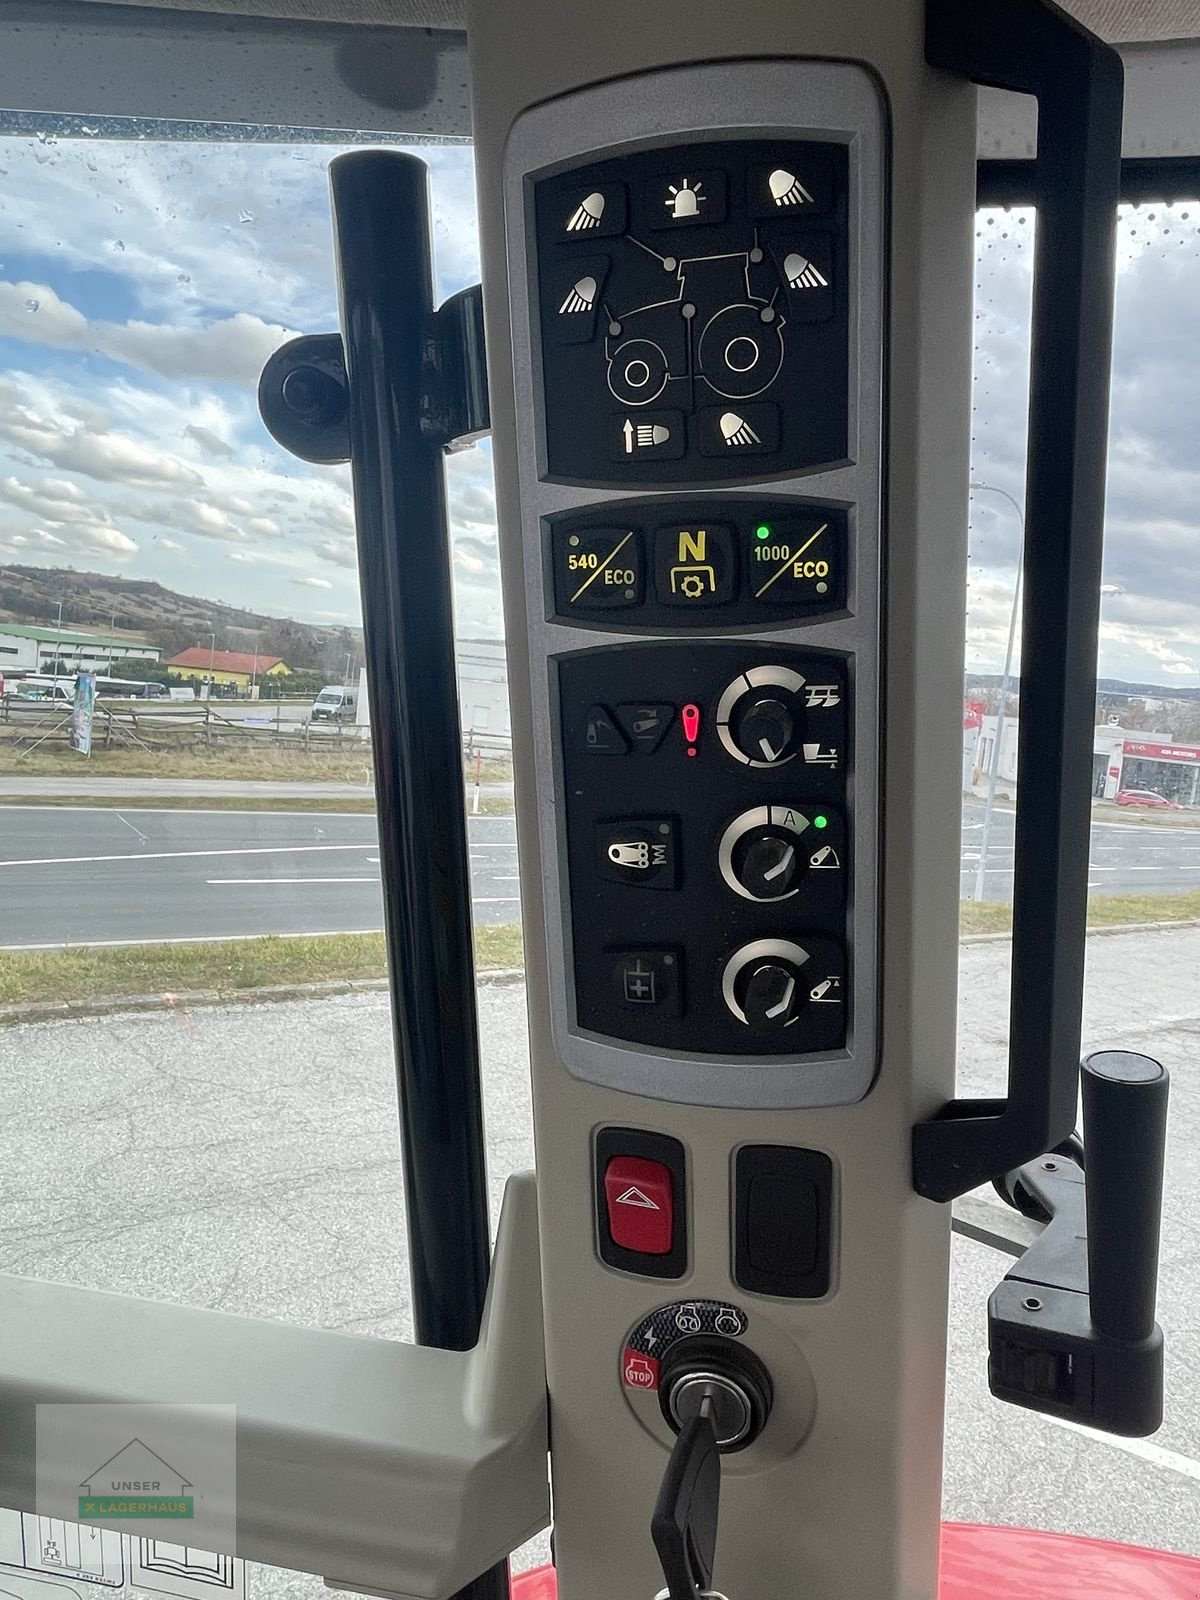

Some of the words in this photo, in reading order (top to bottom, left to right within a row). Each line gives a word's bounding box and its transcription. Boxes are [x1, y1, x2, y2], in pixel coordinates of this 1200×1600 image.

[678, 530, 706, 562] N
[754, 545, 790, 562] 1000
[568, 553, 598, 571] 540
[793, 560, 829, 579] ECO
[604, 569, 635, 585] ECO
[783, 810, 796, 827] A
[628, 1368, 651, 1383] STOP
